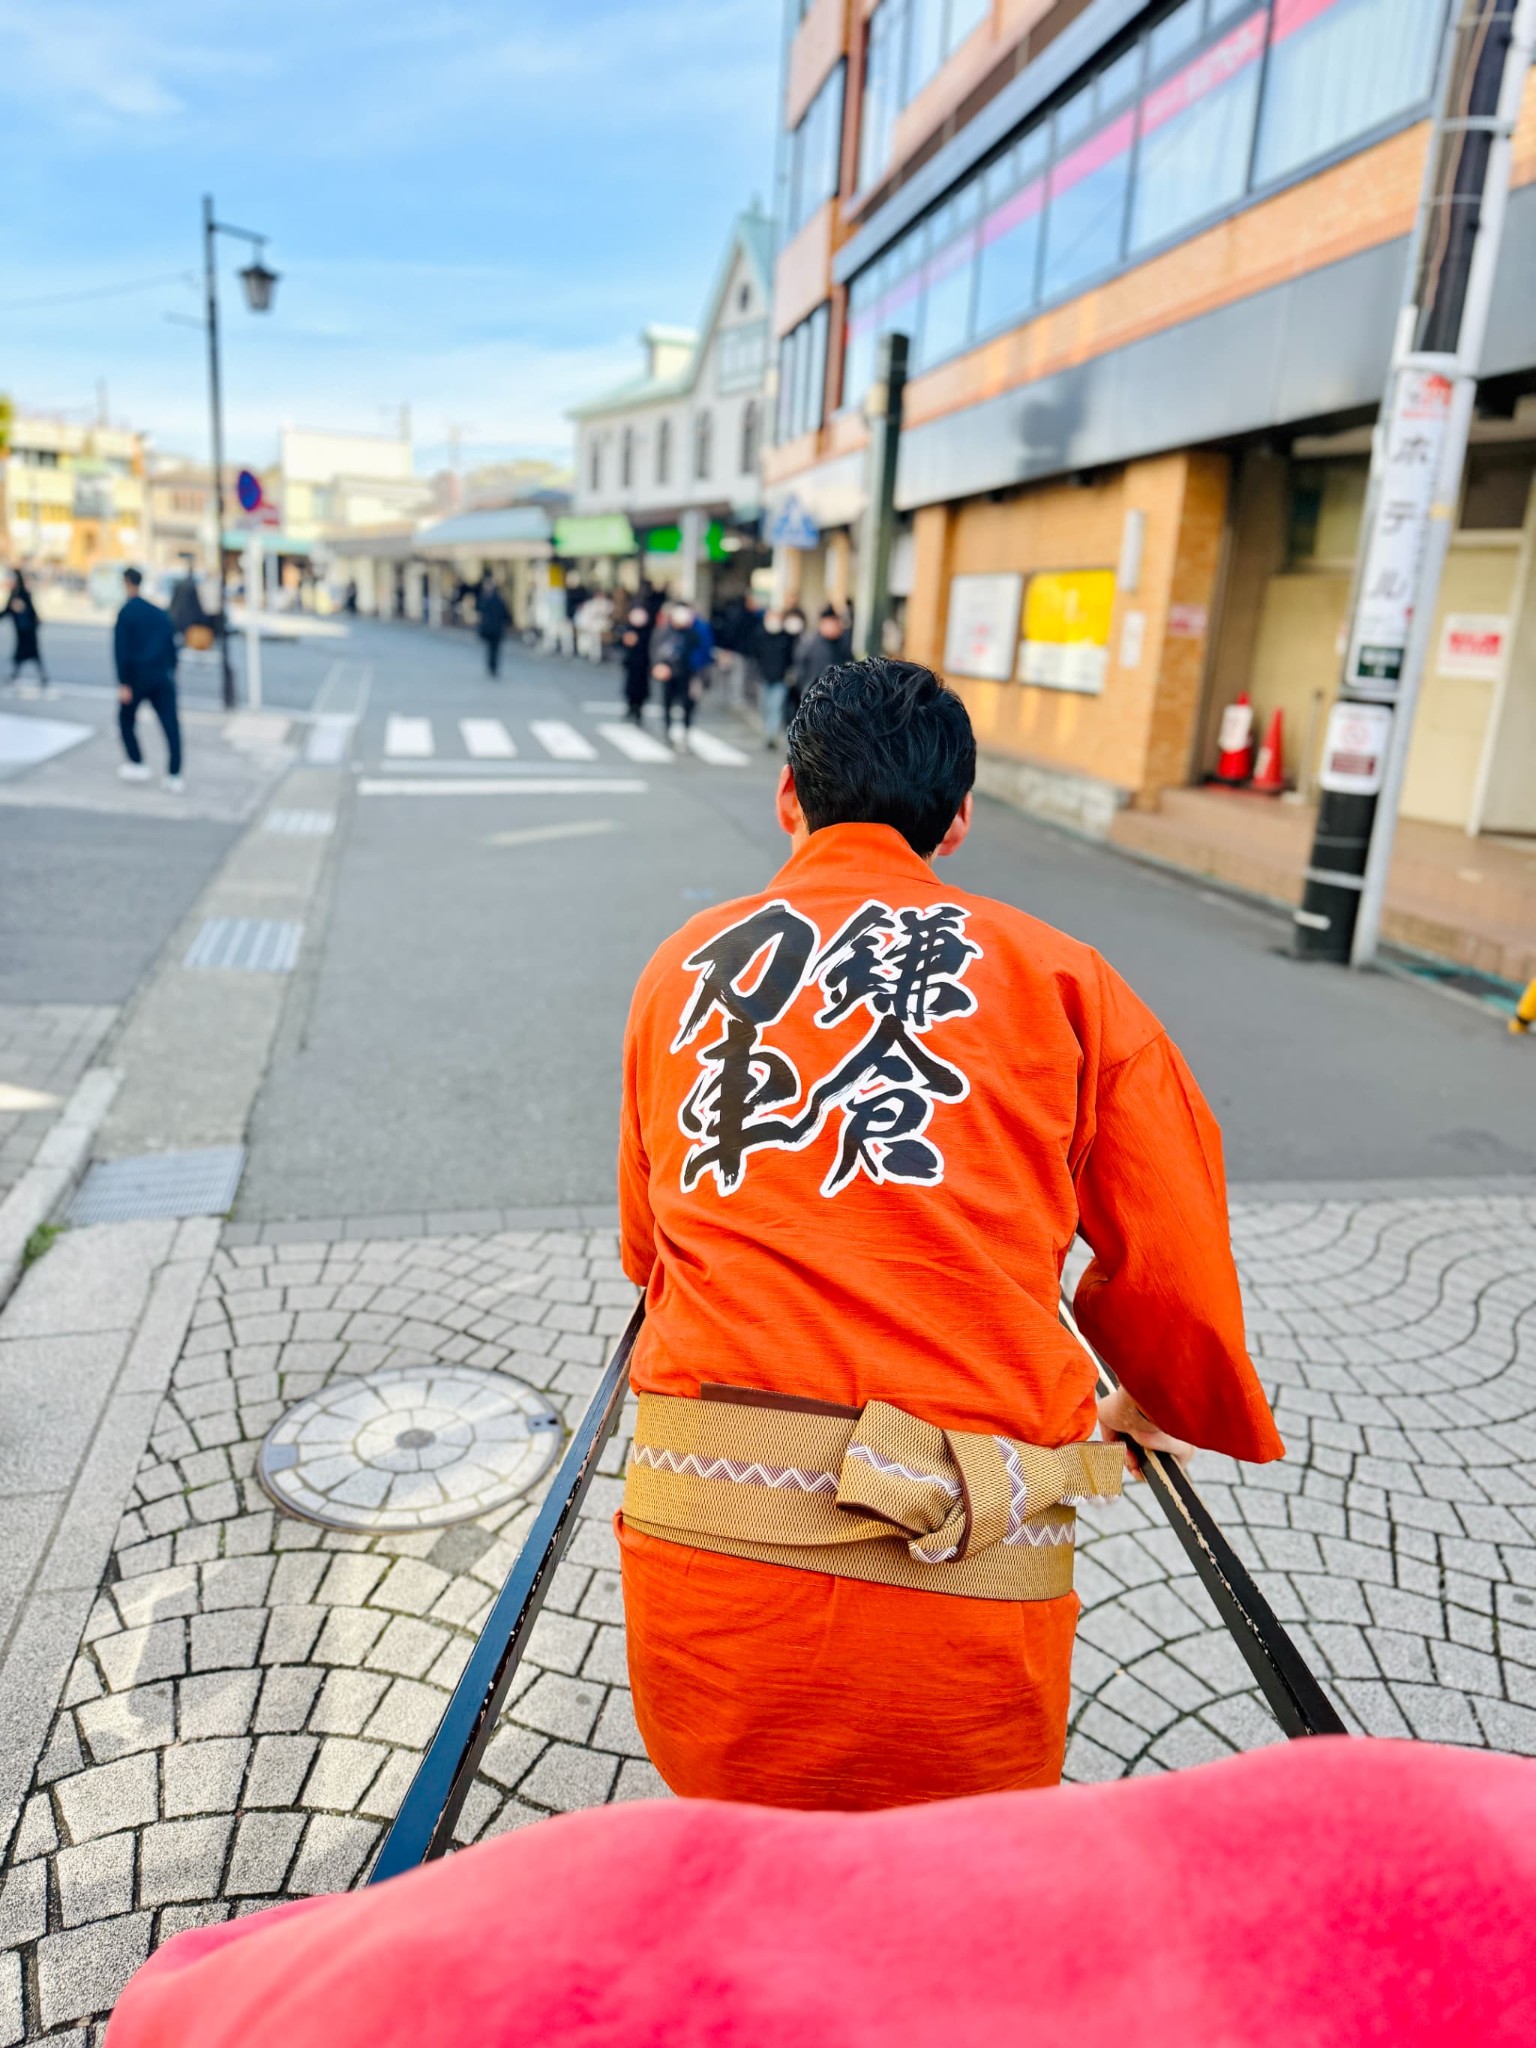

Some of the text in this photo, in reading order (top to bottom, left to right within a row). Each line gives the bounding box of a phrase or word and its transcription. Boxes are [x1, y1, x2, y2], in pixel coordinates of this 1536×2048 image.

[1369, 435, 1430, 600] ホテル
[813, 901, 982, 1196] 鎌倉
